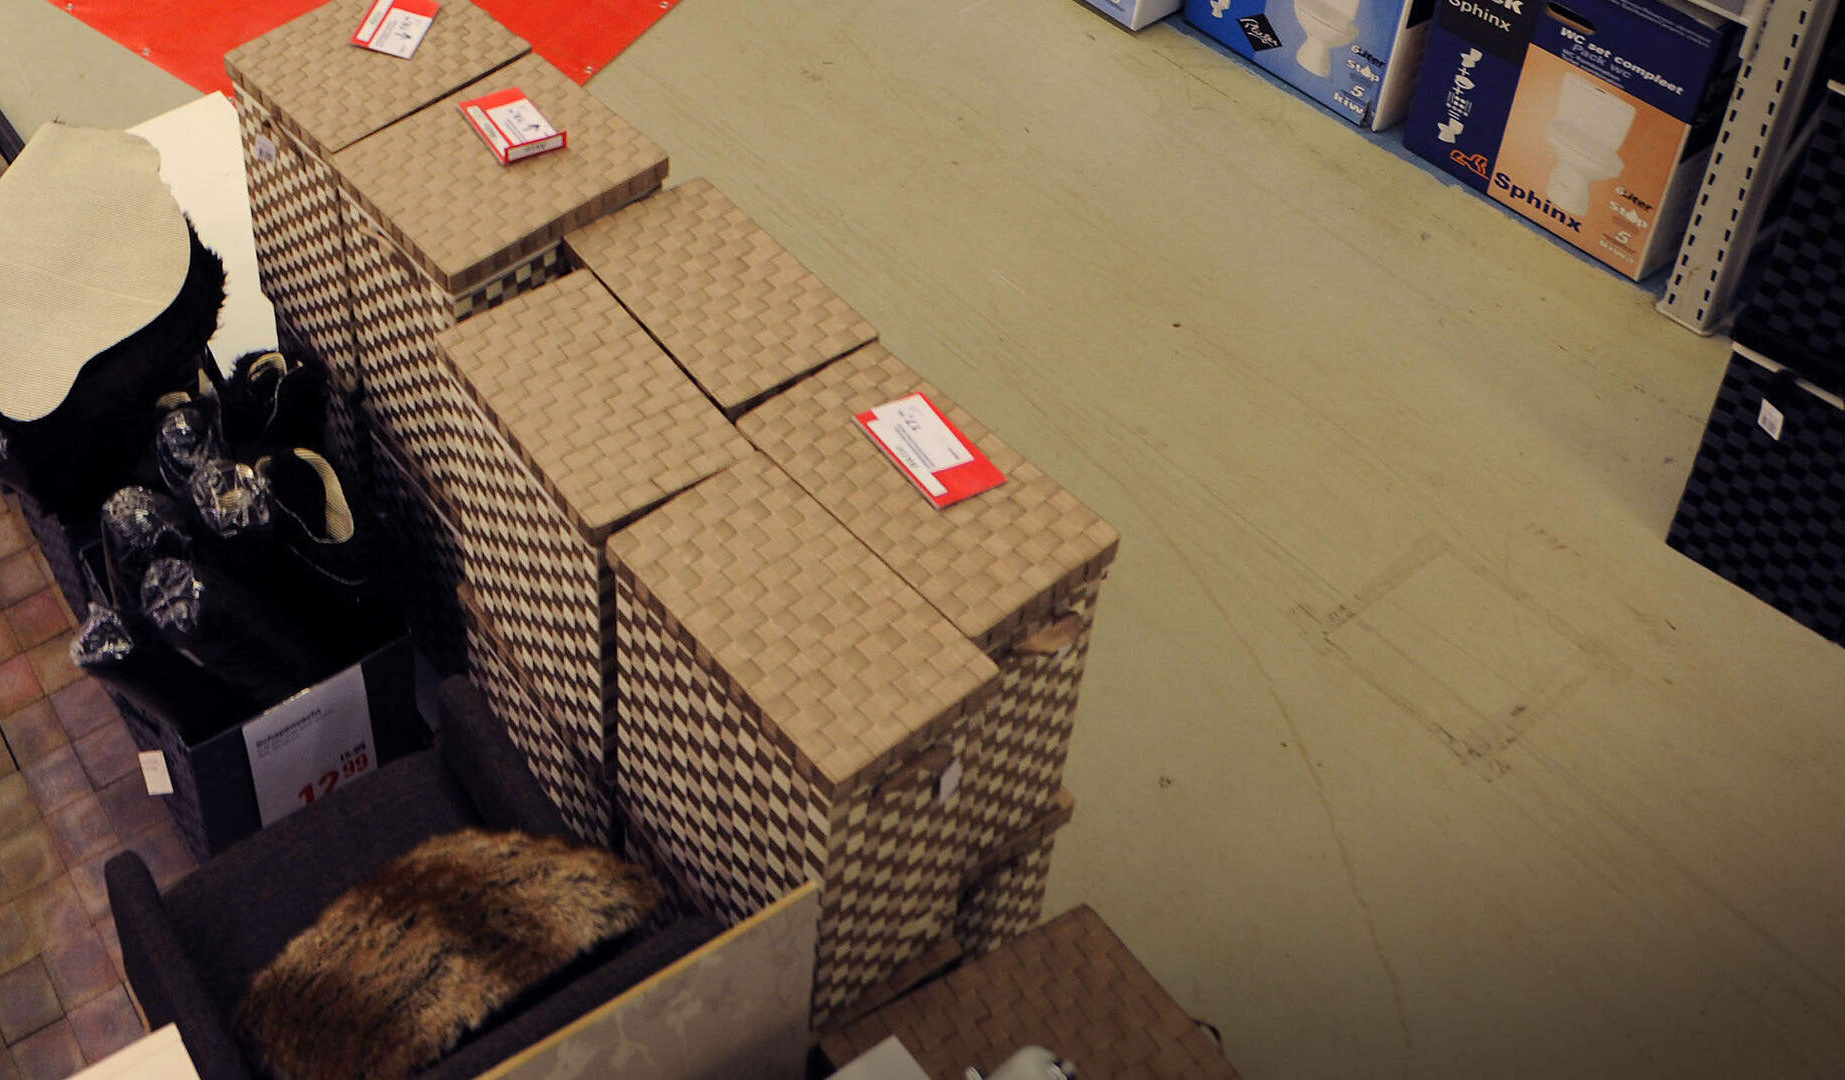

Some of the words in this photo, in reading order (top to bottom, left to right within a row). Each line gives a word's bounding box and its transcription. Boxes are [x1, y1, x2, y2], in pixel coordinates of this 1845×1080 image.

[1560, 25, 1586, 45] WC
[1588, 41, 1612, 60] set
[1613, 53, 1684, 97] compleet
[1571, 43, 1606, 68] Pack
[1351, 85, 1364, 98] 5
[1493, 171, 1583, 234] Sphinx
